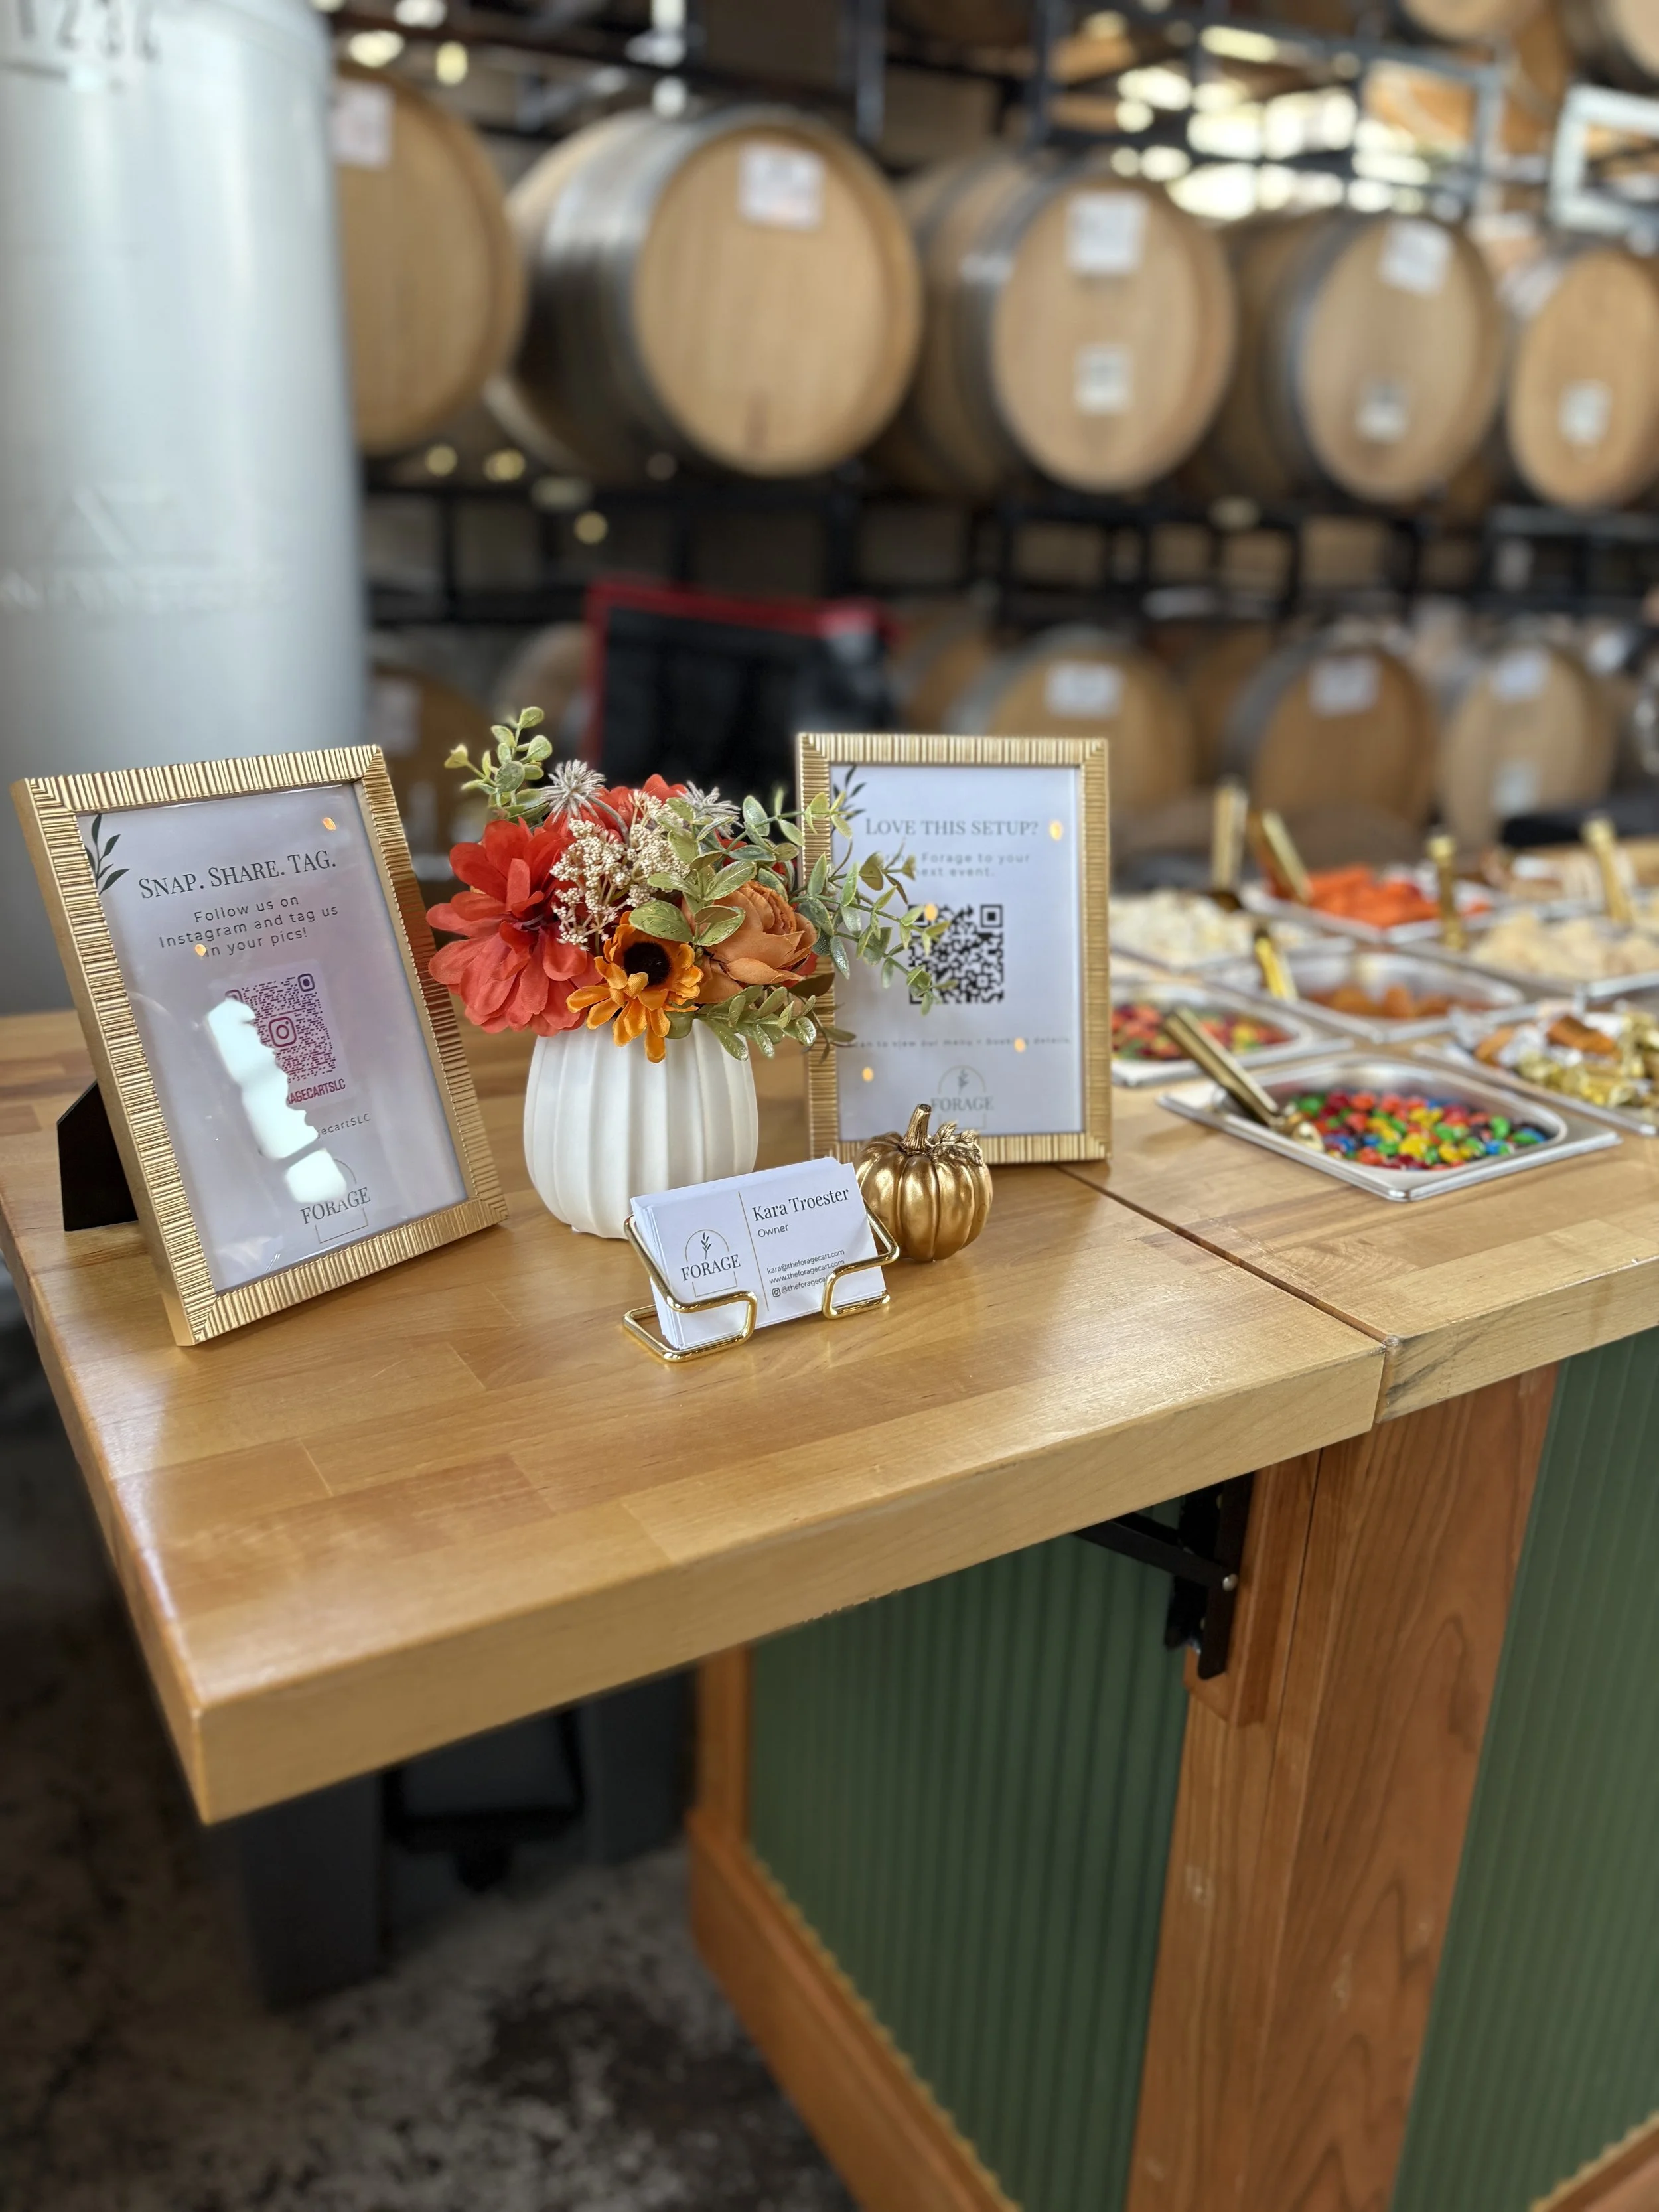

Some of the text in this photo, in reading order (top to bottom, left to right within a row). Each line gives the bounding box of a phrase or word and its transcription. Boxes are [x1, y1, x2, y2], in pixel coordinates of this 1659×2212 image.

[865, 818, 1039, 836] LOVE THIS SETUP?
[922, 852, 971, 867] Forage
[977, 852, 993, 863] to
[997, 853, 1030, 867] your
[138, 850, 336, 899] SNAP. SHARE. TAG.
[194, 896, 299, 923] Follow us on
[159, 905, 338, 948] Instagram and tag us
[226, 936, 263, 956] your
[270, 926, 308, 947] pics!
[931, 1096, 994, 1112] FORAGE
[300, 1187, 371, 1225] FORAGE
[751, 1188, 849, 1222] Kara Troester
[758, 1224, 789, 1238] Owner
[681, 1254, 741, 1282] FORAGE
[766, 1249, 845, 1274] kara@theforagecart.com
[769, 1260, 845, 1284] www.theforagecart.com
